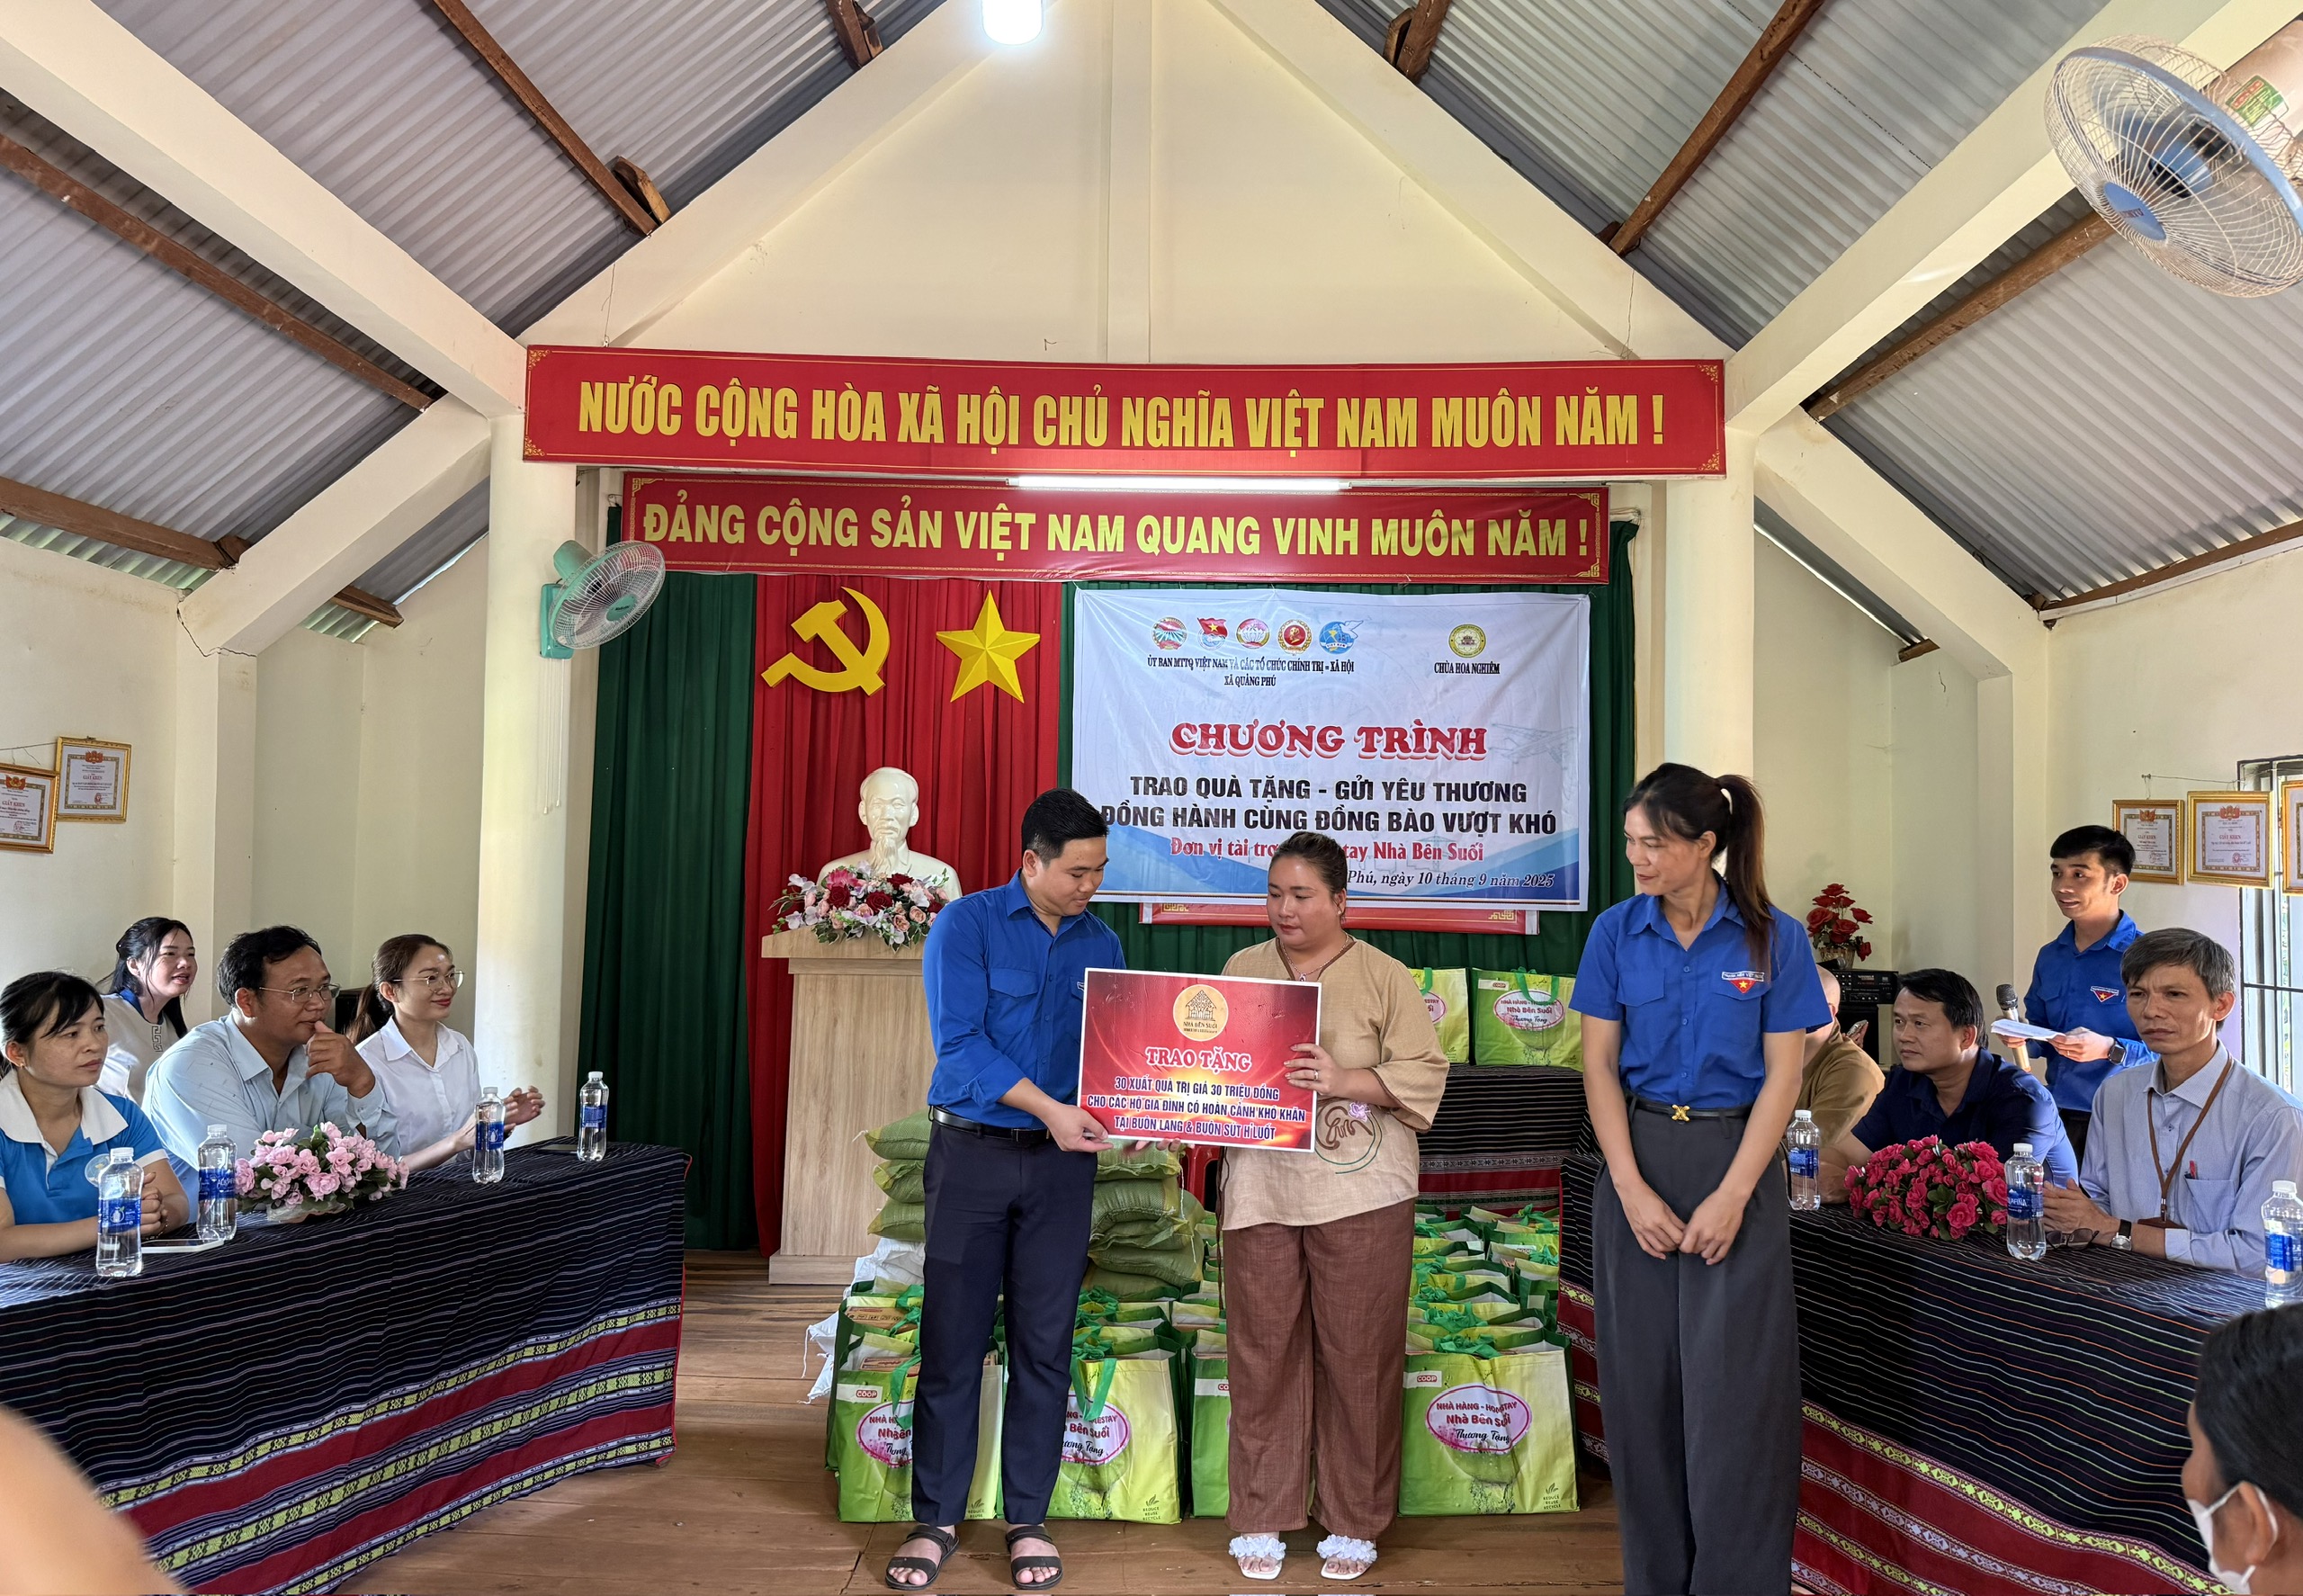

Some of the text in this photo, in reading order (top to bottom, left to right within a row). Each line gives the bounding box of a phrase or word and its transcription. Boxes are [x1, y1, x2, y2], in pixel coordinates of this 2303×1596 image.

[578, 376, 1664, 458] NƯỚC CỘNG HÒA XÃ HỘI CHỦ NGHĨA VIỆT NAM MUÔN NĂM !
[643, 489, 1588, 560] ĐẢNG CỘNG SẢN VIỆT NAM QUANG VINH MUÔN NĂM !
[1158, 658, 1173, 668] BAN
[1173, 658, 1194, 670] MTTQ
[1195, 656, 1211, 671] VIỆT
[1212, 659, 1228, 668] NAM
[1266, 658, 1286, 670] CHỨC
[1287, 658, 1311, 671] CHÍNH
[1312, 660, 1324, 674] TRỊ
[1330, 659, 1340, 672] XÃ
[1340, 659, 1355, 675] HỘI
[1434, 659, 1501, 674] CHÙA HOA NGHIÊM
[1223, 673, 1277, 687] XÃ QUẢNG PHÚ
[1169, 719, 1487, 760] CHƯƠNG TRÌNH
[1130, 776, 1187, 796] TRAO
[1196, 775, 1242, 800] QUÀ
[1250, 776, 1311, 802] TẶNG
[1335, 775, 1374, 801] GỬI
[1382, 778, 1425, 801] YÊU
[1433, 780, 1527, 802] THƯƠNG
[1101, 800, 1556, 838] ĐỒNG HÀNH CÙNG ĐỒNG BÀO VƯỢT KHÓ
[1171, 837, 1204, 856] Đơn
[1208, 838, 1223, 859] vị
[1228, 840, 1250, 856] tài
[1373, 842, 1407, 860] Nhà
[1412, 842, 1443, 860] Bên
[1447, 842, 1483, 861] Suối
[1348, 870, 1555, 888] Phú, ngày 10 tháng 9 năm 2025
[1145, 1046, 1251, 1074] TRAO TẶNG
[1116, 1077, 1126, 1089] 30
[1129, 1074, 1152, 1090] XUẤT
[1155, 1078, 1173, 1093] QUÀ
[1176, 1080, 1190, 1096] TRỊ
[1193, 1080, 1208, 1095] GIÁ
[1211, 1084, 1222, 1096] 30
[1224, 1083, 1252, 1100] TRIỆU
[1088, 1096, 1106, 1107] CHO
[1108, 1095, 1127, 1108] CÁC
[1130, 1096, 1142, 1112] HỘ
[1144, 1098, 1160, 1110] GIA
[1162, 1098, 1185, 1112] ĐÌNH
[1187, 1099, 1199, 1114] CÓ
[1202, 1101, 1227, 1116] HOÀN
[1230, 1102, 1257, 1117] CẢNH
[1279, 1107, 1305, 1121] KHĂN
[1115, 1116, 1129, 1131] TẠI
[1132, 1116, 1156, 1130] BUÔN
[1160, 1119, 1183, 1132] LANG
[1186, 1122, 1193, 1133] &
[1196, 1121, 1221, 1135] BUÔN
[857, 1390, 877, 1398] COOP
[1067, 1411, 1079, 1419] NG
[1437, 1401, 1454, 1411] NHÀ
[1456, 1401, 1480, 1411] HÀNG
[870, 1414, 887, 1424] NHÀ
[1447, 1413, 1468, 1424] Nhà
[1472, 1414, 1492, 1425] Bên
[1070, 1422, 1089, 1435] Bên
[1089, 1425, 1110, 1439] Suối
